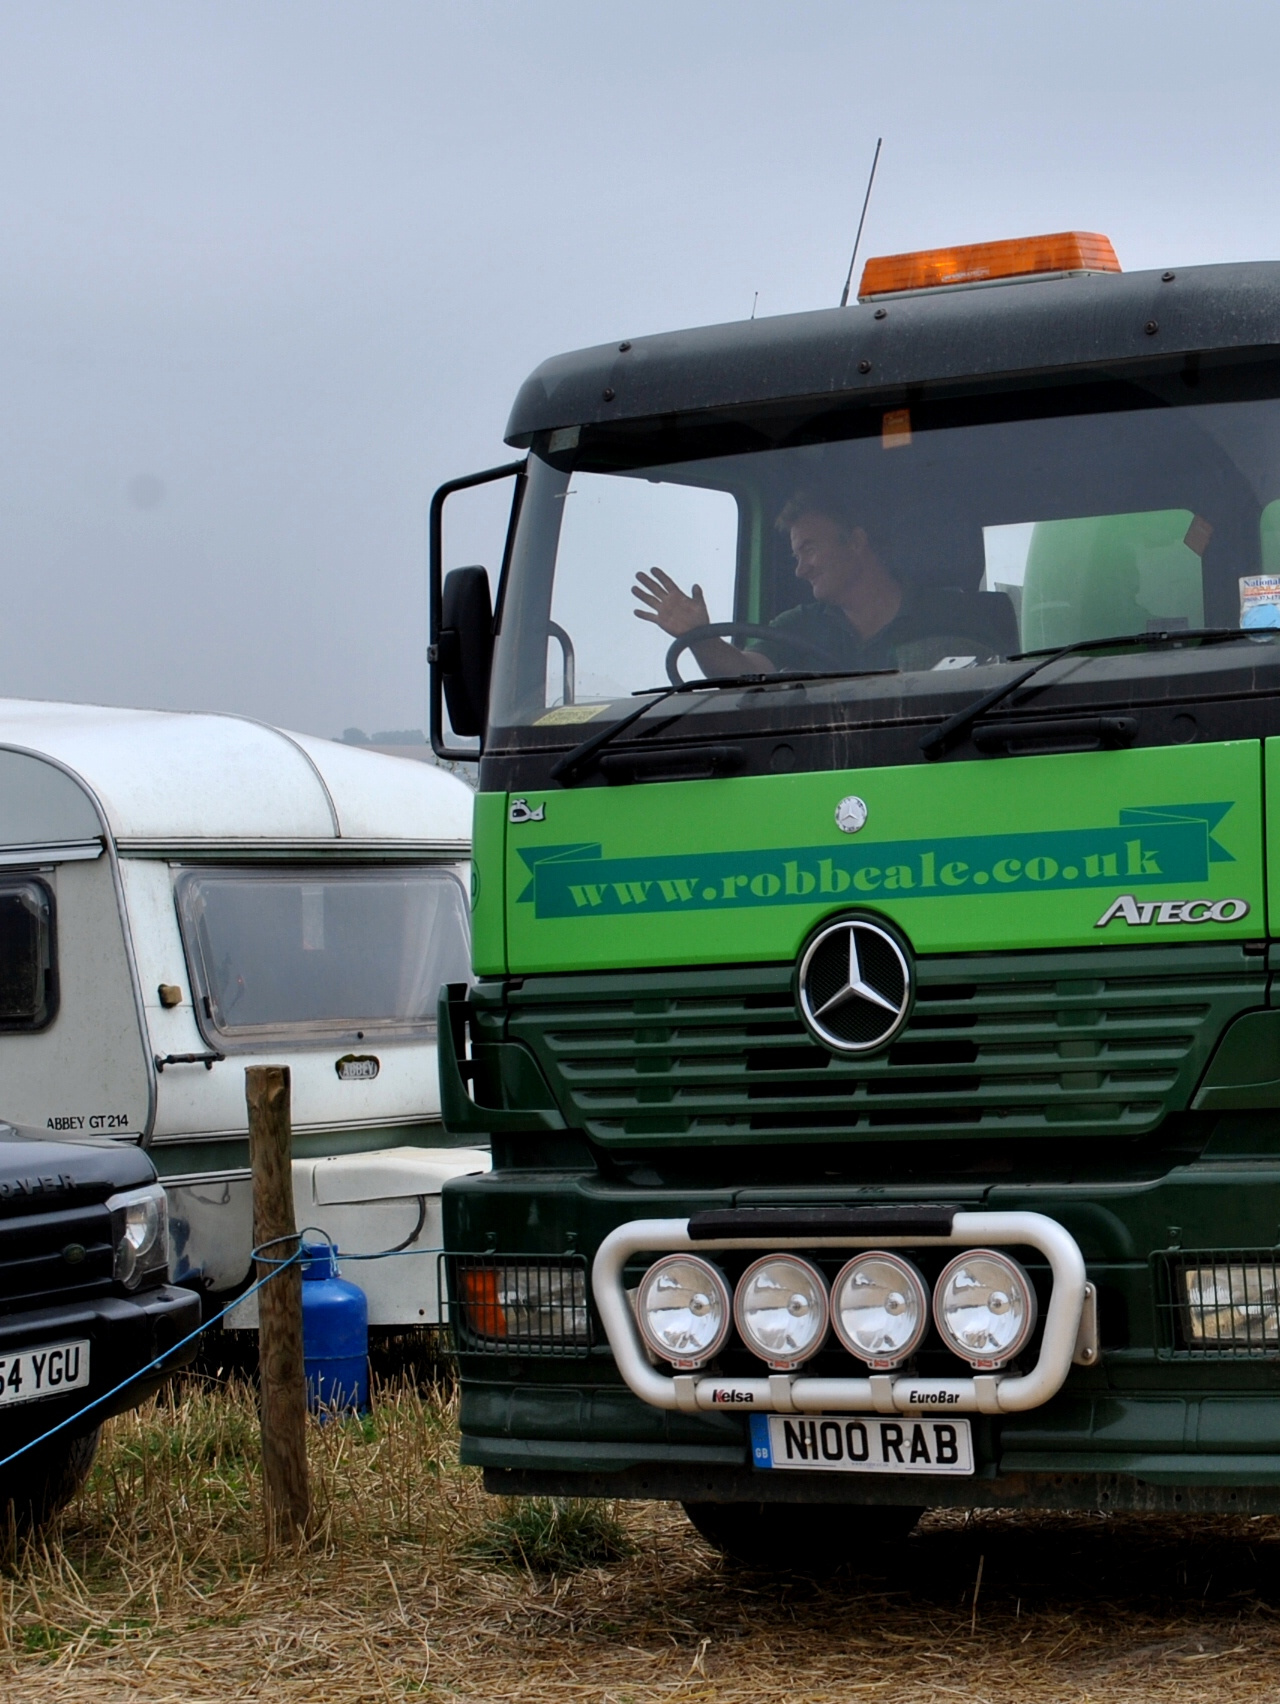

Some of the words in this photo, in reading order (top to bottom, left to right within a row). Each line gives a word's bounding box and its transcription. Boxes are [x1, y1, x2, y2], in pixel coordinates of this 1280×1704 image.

[1244, 577, 1280, 587] National
[568, 839, 1163, 908] www.robbeale.co.uk
[1094, 895, 1251, 928] ATEGO
[342, 1061, 376, 1076] ABBEY
[47, 1116, 85, 1130] ABBEY
[32, 1346, 80, 1389] YGU
[712, 1389, 754, 1403] Kelsa
[909, 1390, 960, 1404] EuroBar
[880, 1423, 959, 1465] RAB
[755, 1447, 769, 1459] GB
